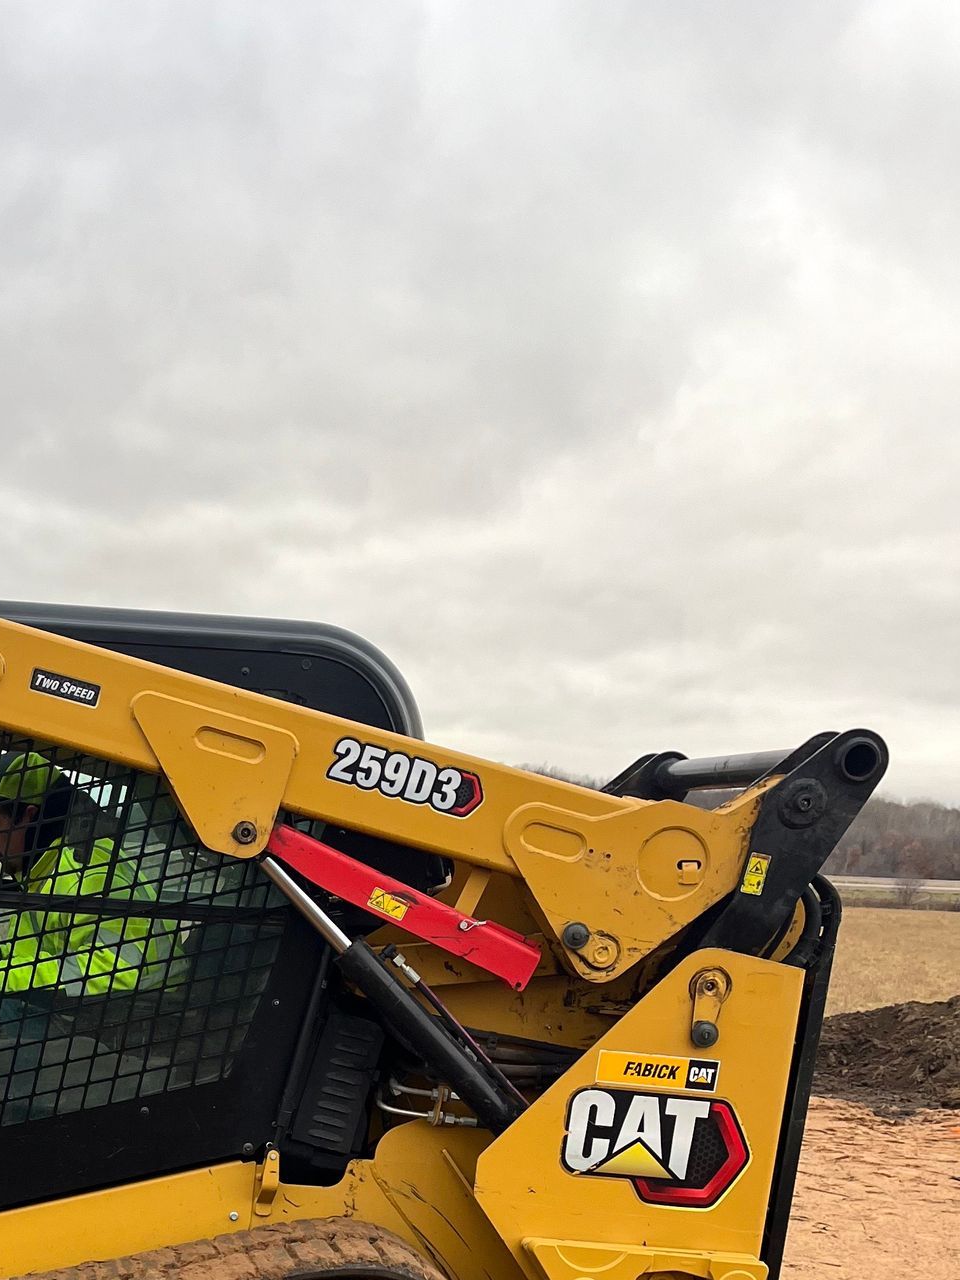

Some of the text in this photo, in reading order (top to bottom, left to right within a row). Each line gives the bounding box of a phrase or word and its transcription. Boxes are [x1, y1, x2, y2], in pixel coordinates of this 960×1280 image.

[328, 738, 462, 810] 259D3
[623, 1061, 715, 1084] FABICK CAT
[564, 1089, 711, 1180] CAT
